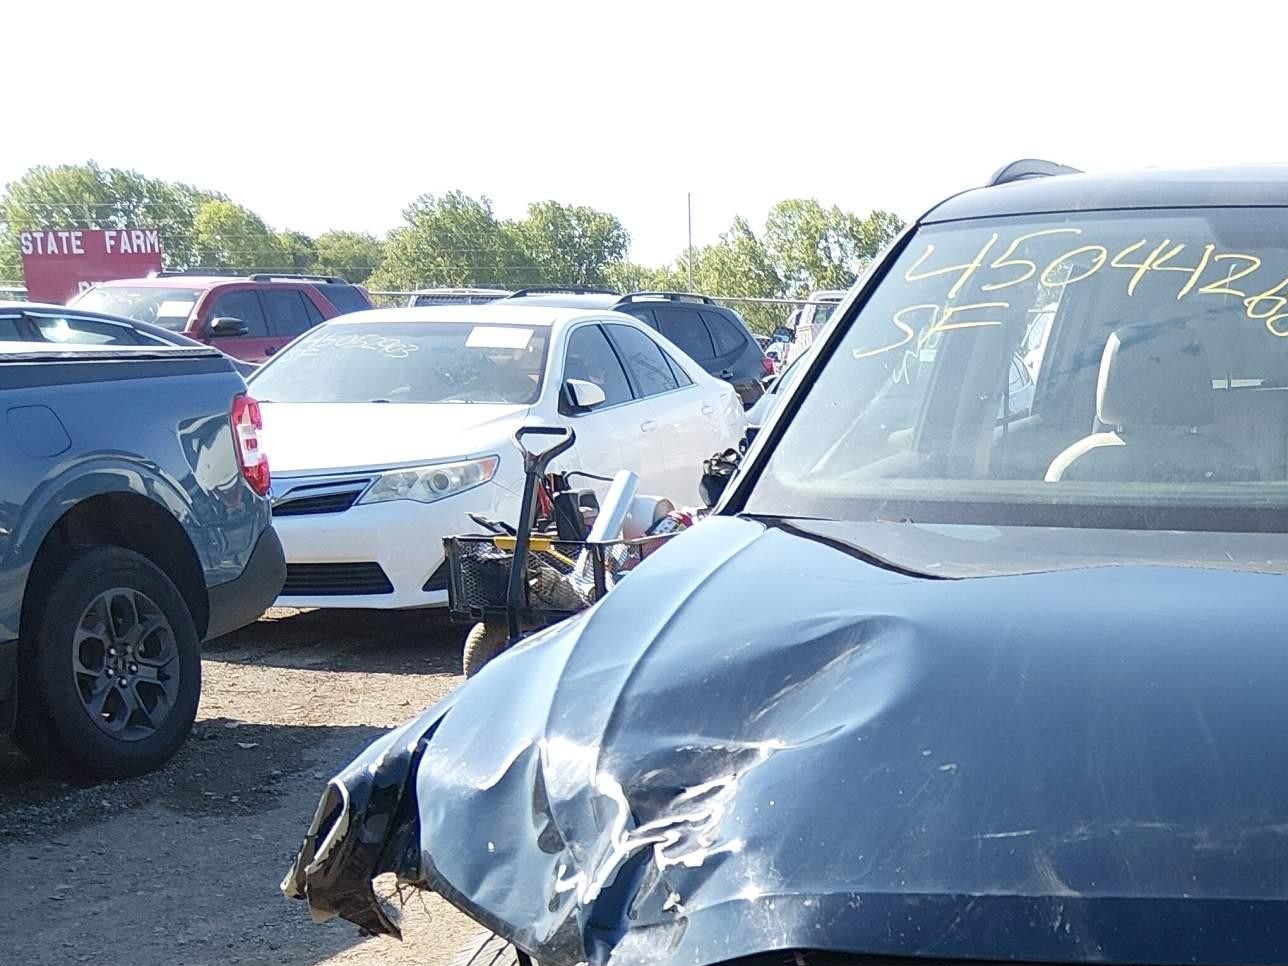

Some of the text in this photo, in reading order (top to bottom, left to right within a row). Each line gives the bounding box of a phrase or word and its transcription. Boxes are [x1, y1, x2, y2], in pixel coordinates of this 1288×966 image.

[20, 230, 160, 255] STATE FARM
[854, 302, 1010, 358] SF
